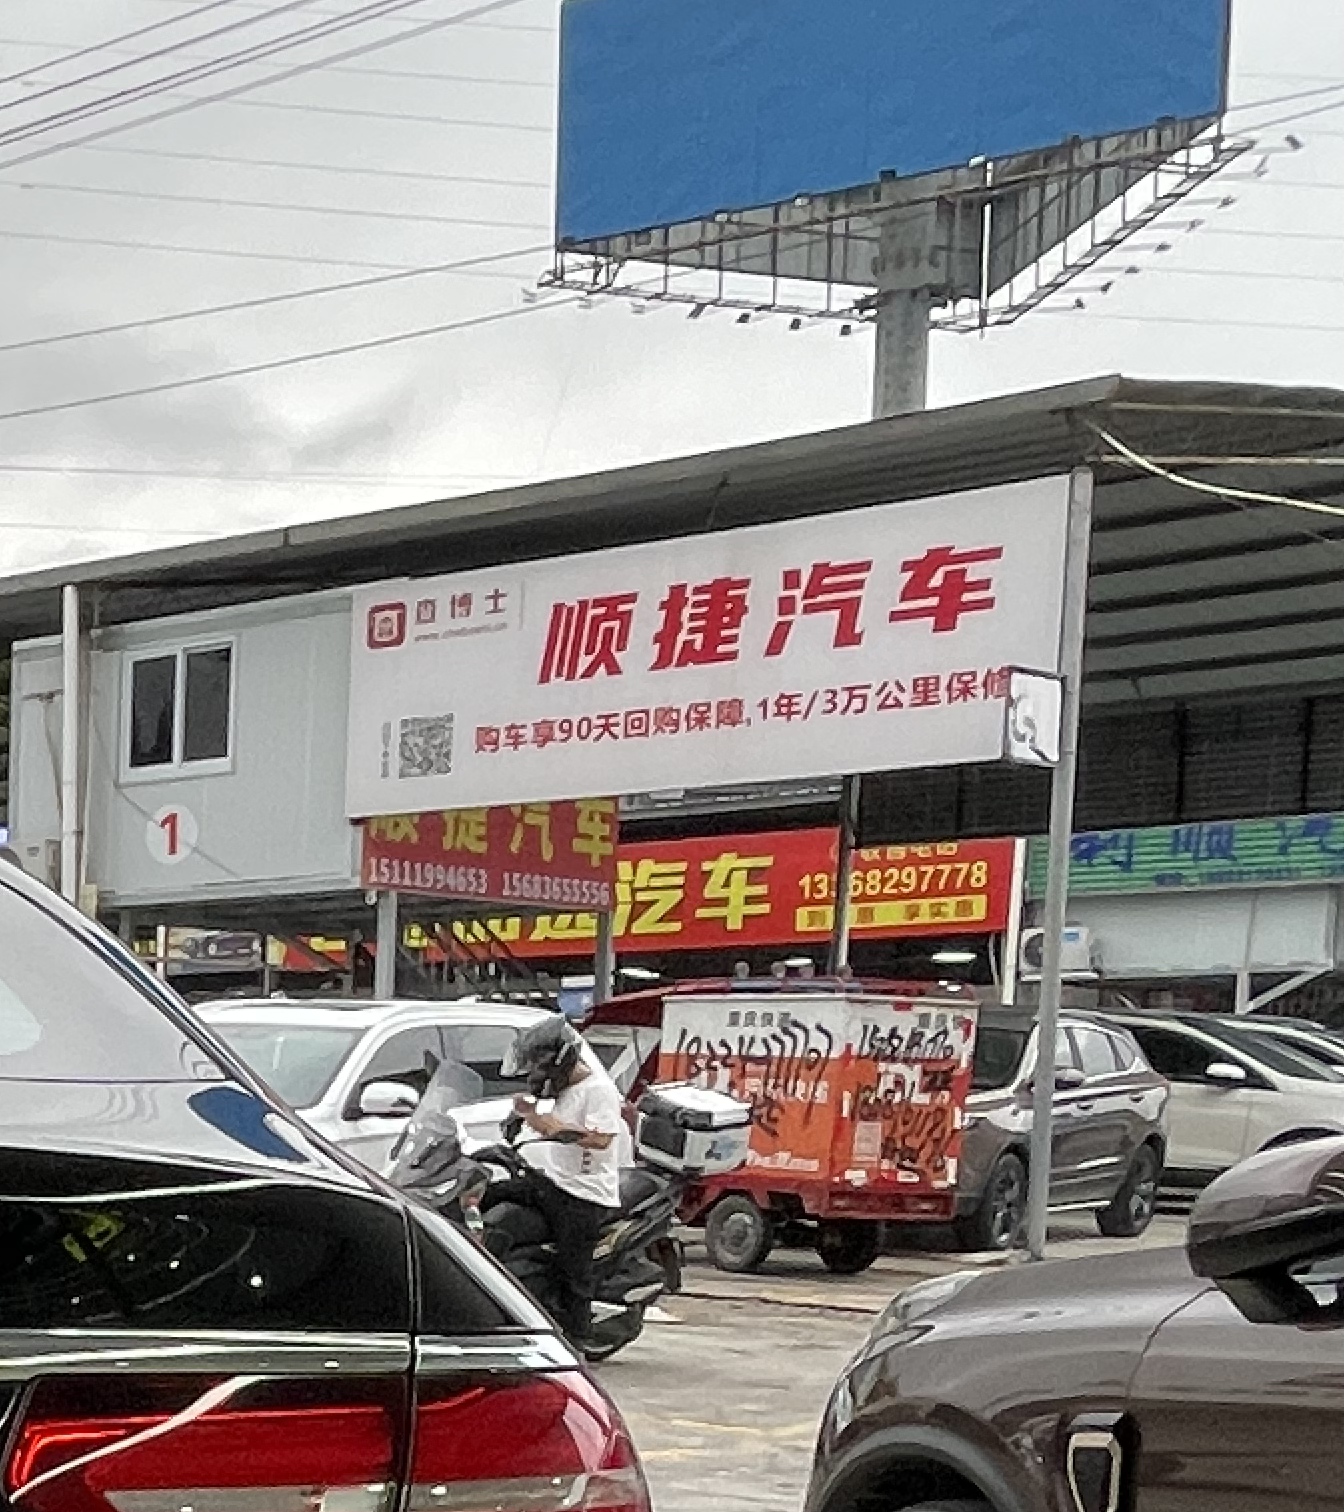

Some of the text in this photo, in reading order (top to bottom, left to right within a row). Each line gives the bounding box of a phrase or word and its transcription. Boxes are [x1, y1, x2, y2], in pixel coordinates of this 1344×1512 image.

[538, 545, 1004, 684] 顺捷汽车
[160, 812, 178, 856] 1
